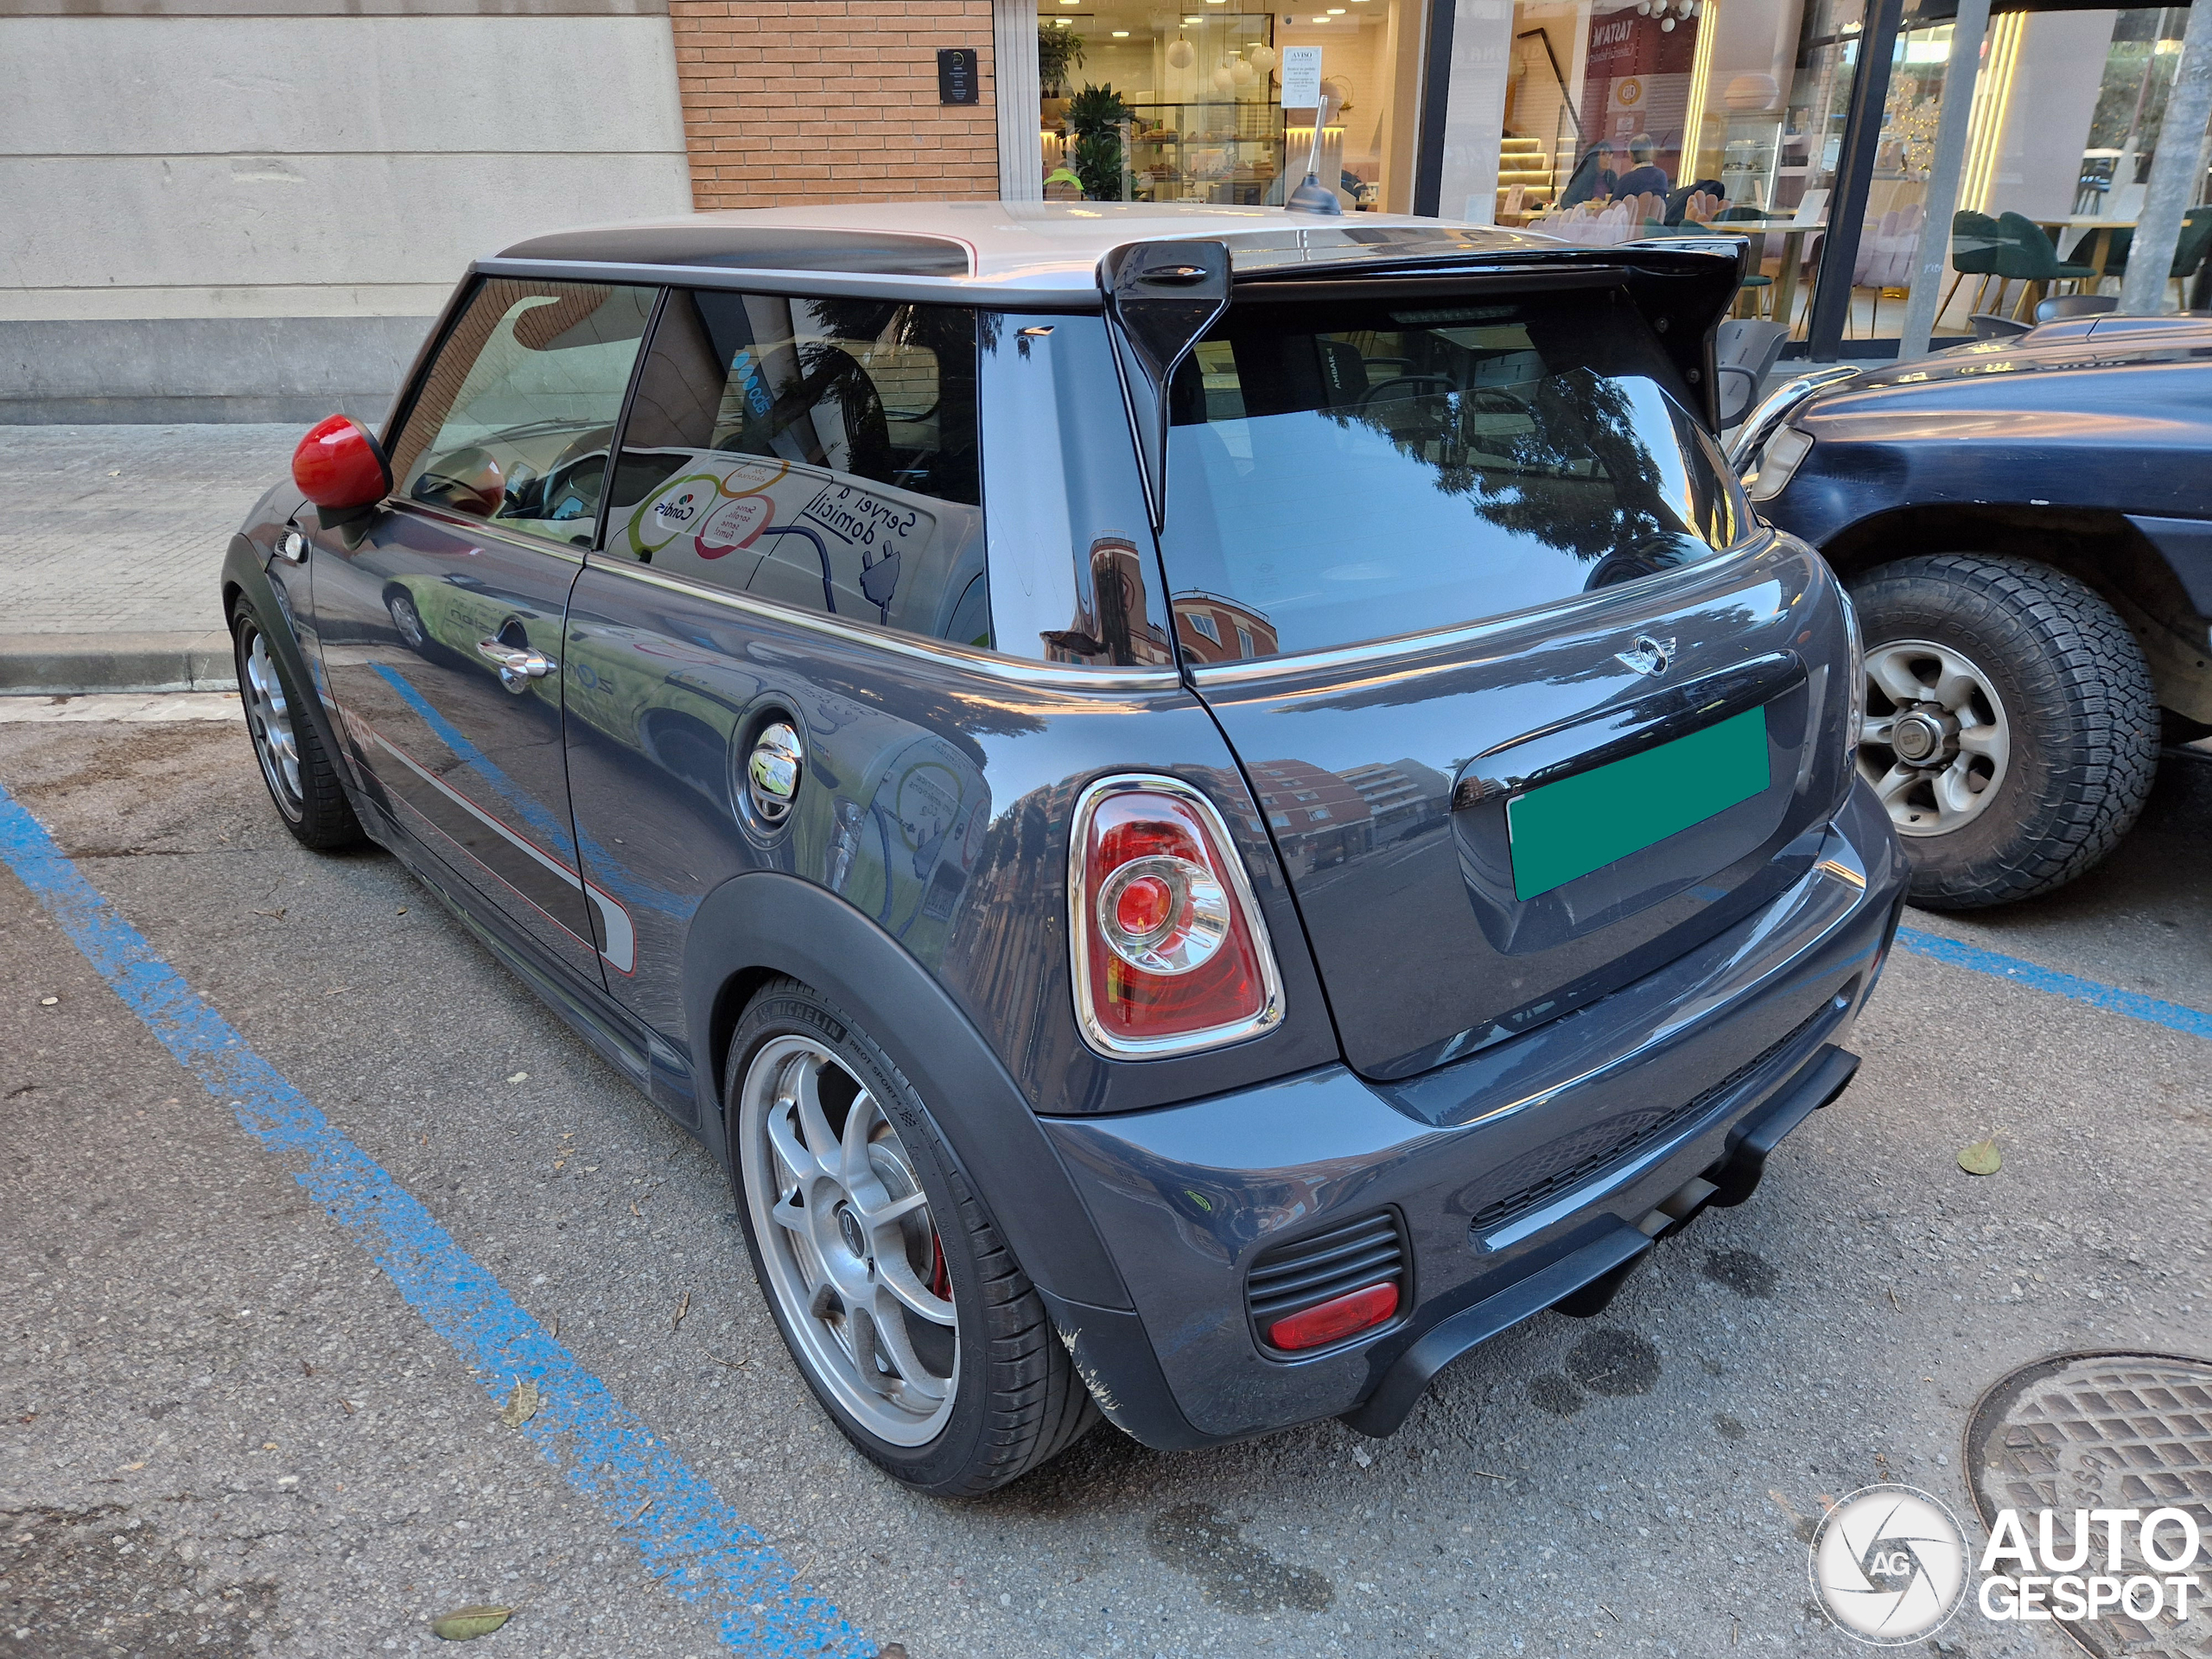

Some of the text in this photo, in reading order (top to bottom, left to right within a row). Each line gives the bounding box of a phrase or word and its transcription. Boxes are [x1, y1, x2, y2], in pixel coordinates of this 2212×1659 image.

[1328, 354, 1342, 390] AMBAR
[1867, 609, 1943, 629] OPEN
[344, 708, 374, 751] GP
[772, 1001, 842, 1038] MICHELIN
[849, 1039, 872, 1065] PILOT
[871, 1066, 898, 1099] SPORT
